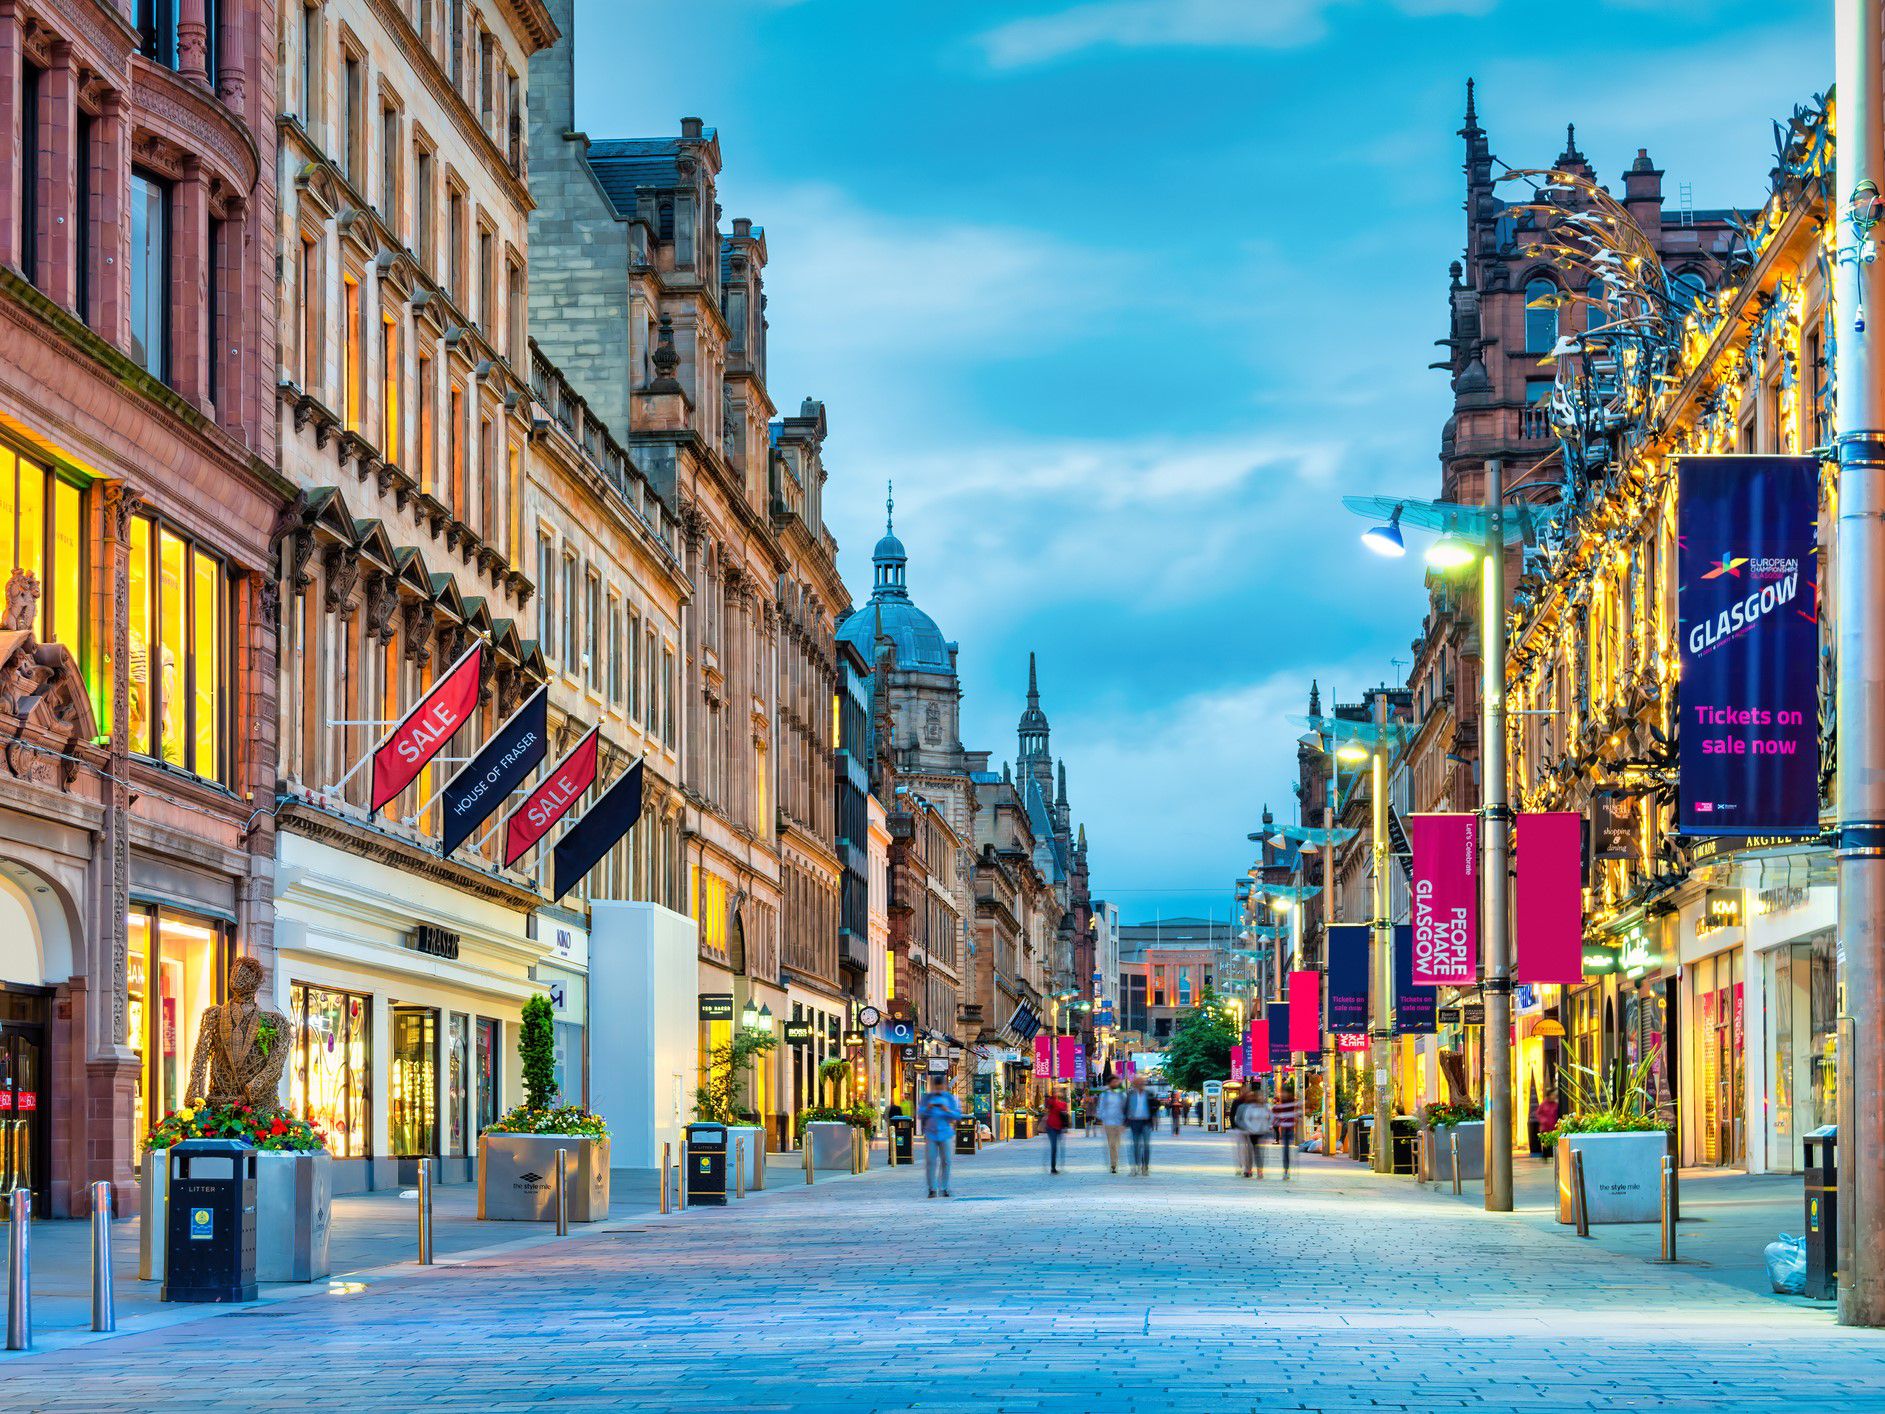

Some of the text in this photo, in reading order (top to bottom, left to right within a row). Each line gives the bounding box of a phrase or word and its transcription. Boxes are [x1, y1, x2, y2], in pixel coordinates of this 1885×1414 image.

[1750, 558, 1798, 567] EUROPEAN
[1689, 572, 1798, 653] GLASGOW
[397, 701, 457, 763] SALE
[1694, 705, 1803, 725] Tickets on
[1701, 734, 1797, 755] sale now
[453, 732, 538, 816] HOUSE OF FRASER
[527, 775, 578, 828] SALE
[1465, 823, 1473, 876] Let's Celebrate
[1603, 826, 1631, 837] shopping
[1606, 844, 1627, 853] dining
[1416, 879, 1432, 975] GLASGOW
[1712, 901, 1738, 914] KM
[425, 926, 461, 961] FRASERS
[556, 928, 572, 949] KIKO
[1433, 922, 1450, 976] MAKE
[1451, 907, 1467, 976] PEOPLE
